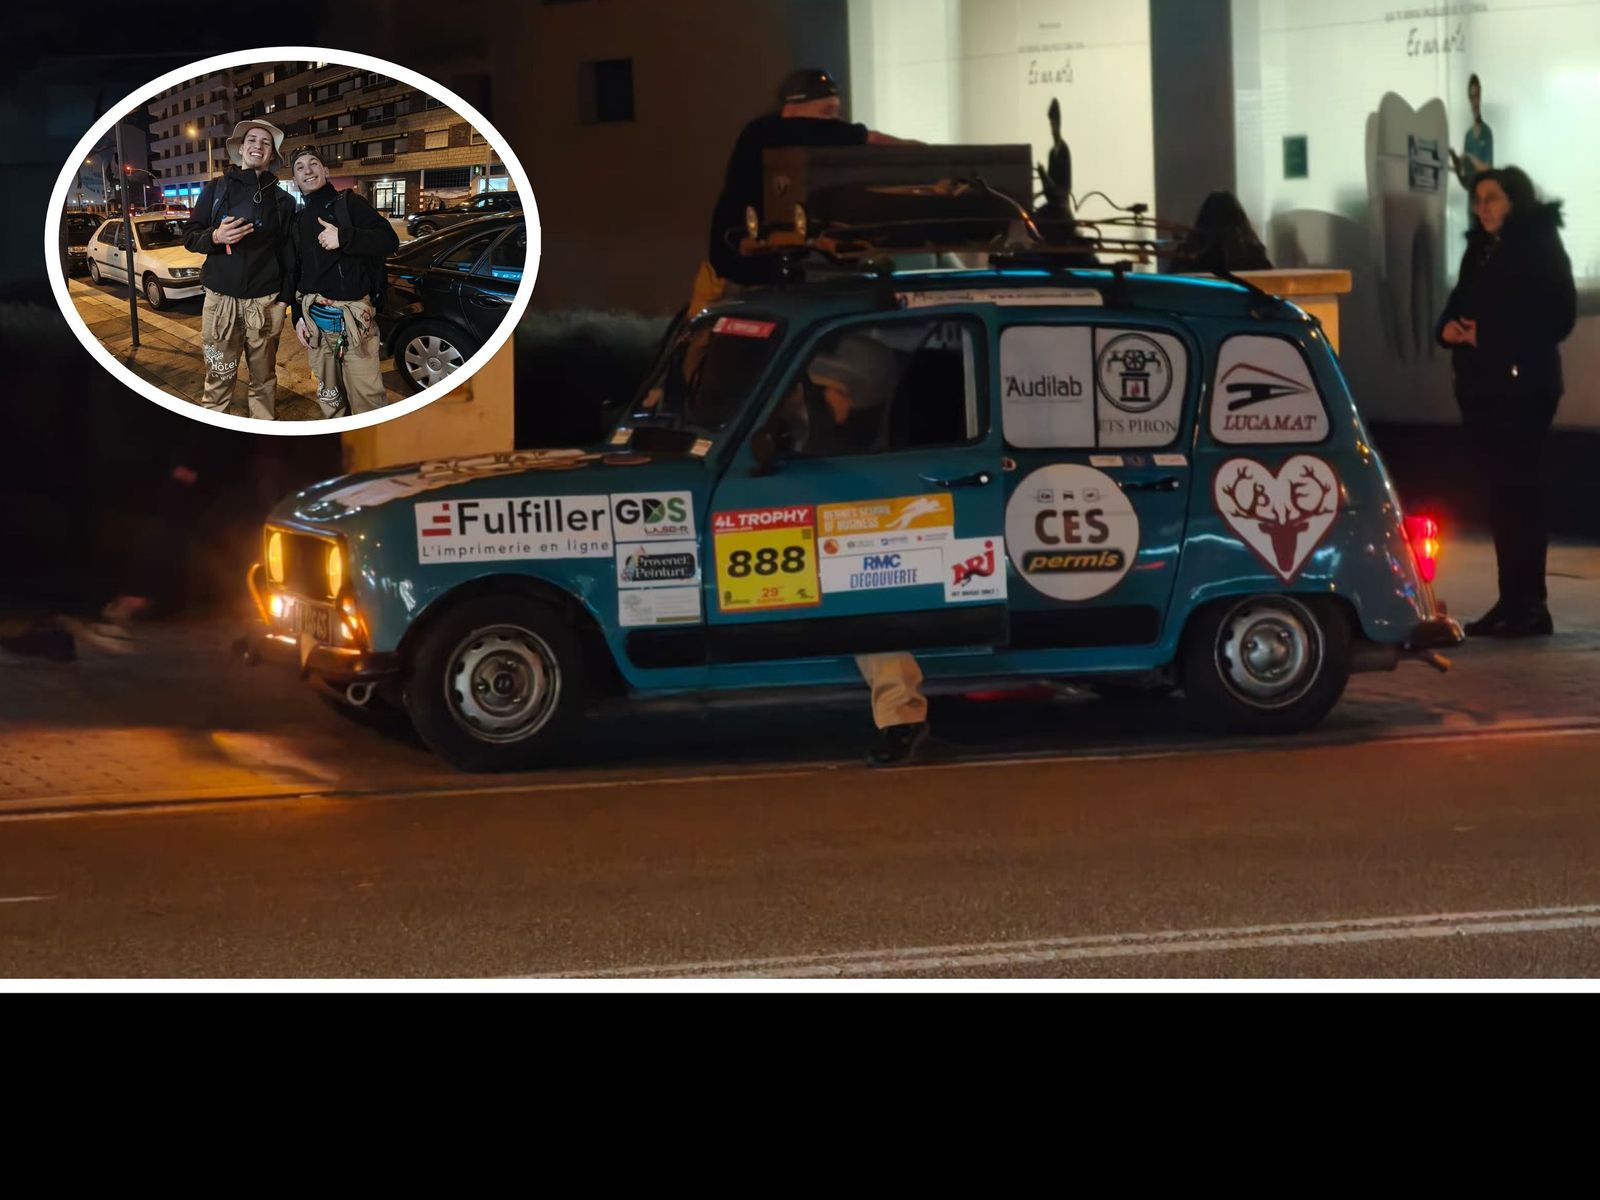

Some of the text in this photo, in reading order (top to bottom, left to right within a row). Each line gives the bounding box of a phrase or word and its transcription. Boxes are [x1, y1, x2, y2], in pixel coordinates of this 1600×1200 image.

[211, 359, 238, 371] Hôtel
[1006, 376, 1082, 398] Audilab
[1128, 419, 1176, 433] PIRON
[1223, 414, 1316, 431] LUCAMAT
[457, 499, 605, 535] Fulfiller
[615, 497, 687, 525] GDS
[715, 509, 808, 528] 4L TROPHY
[1035, 508, 1109, 545] CES
[422, 539, 609, 559] L'imprimerie en ligne
[727, 546, 805, 578] 888
[863, 553, 901, 570] RMC
[1028, 550, 1118, 573] permis
